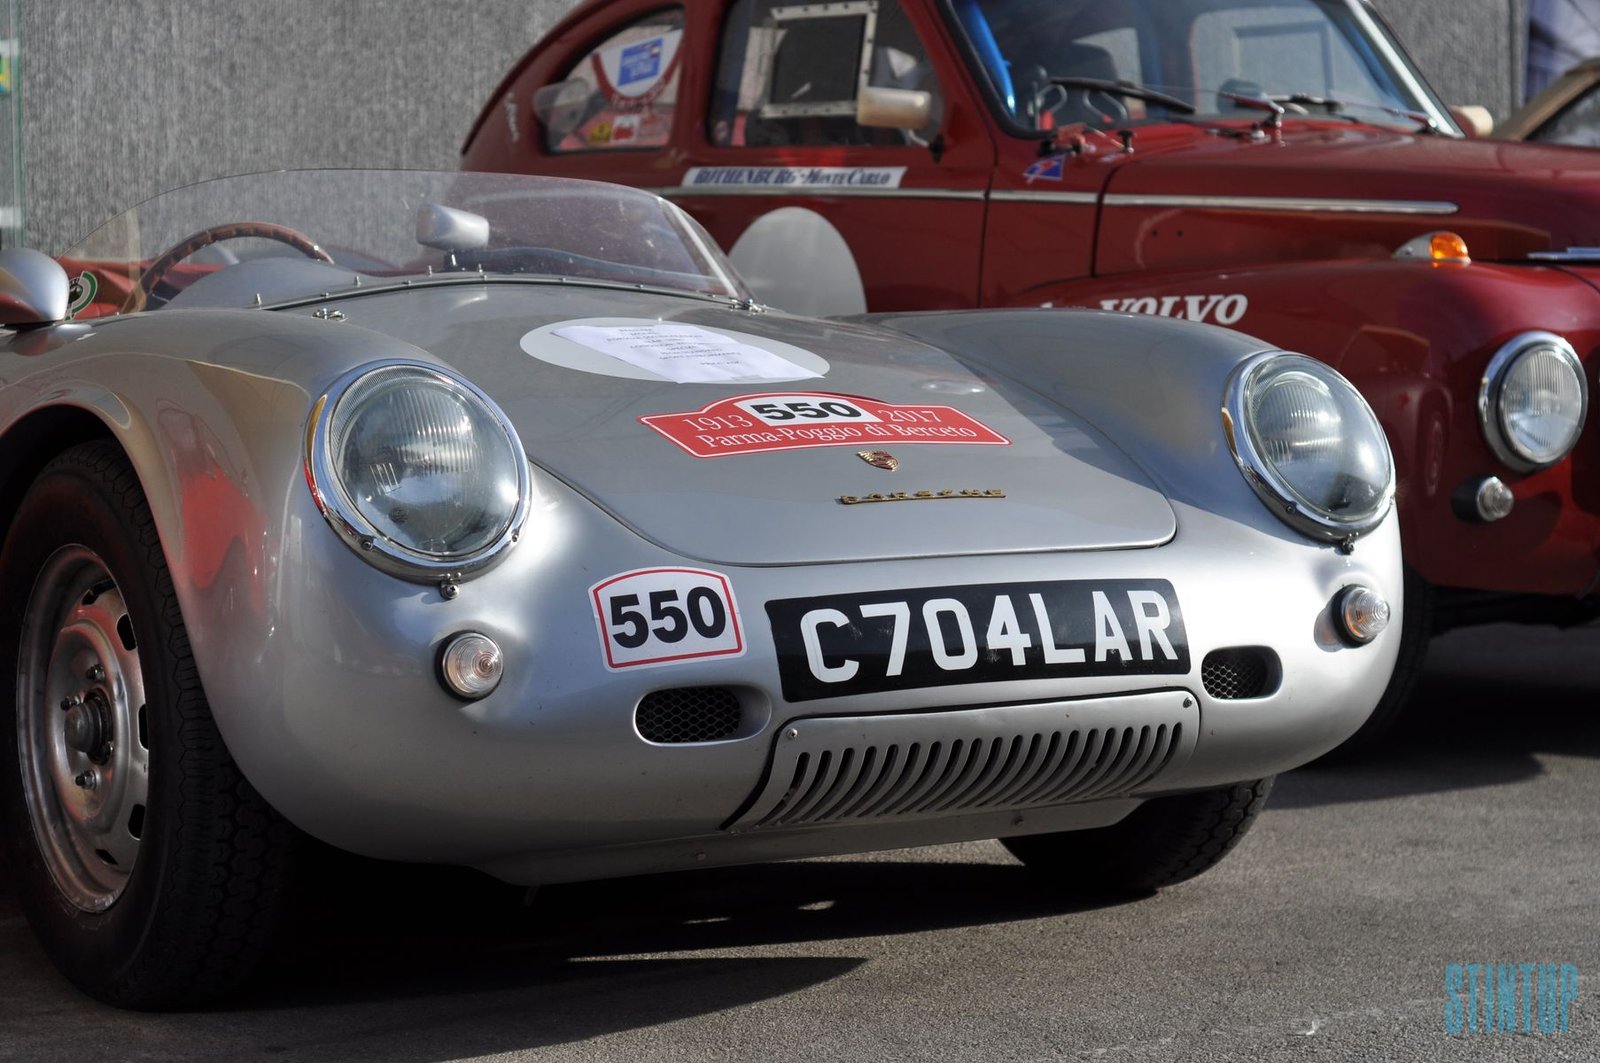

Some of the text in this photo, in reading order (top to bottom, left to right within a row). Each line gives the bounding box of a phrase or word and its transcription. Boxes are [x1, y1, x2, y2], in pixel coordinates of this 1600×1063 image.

[682, 401, 942, 432] 1913 550 2017
[696, 424, 978, 448] Parma-Poggio di Berceto
[609, 586, 726, 648] 550
[800, 590, 1178, 683] C704LAR
